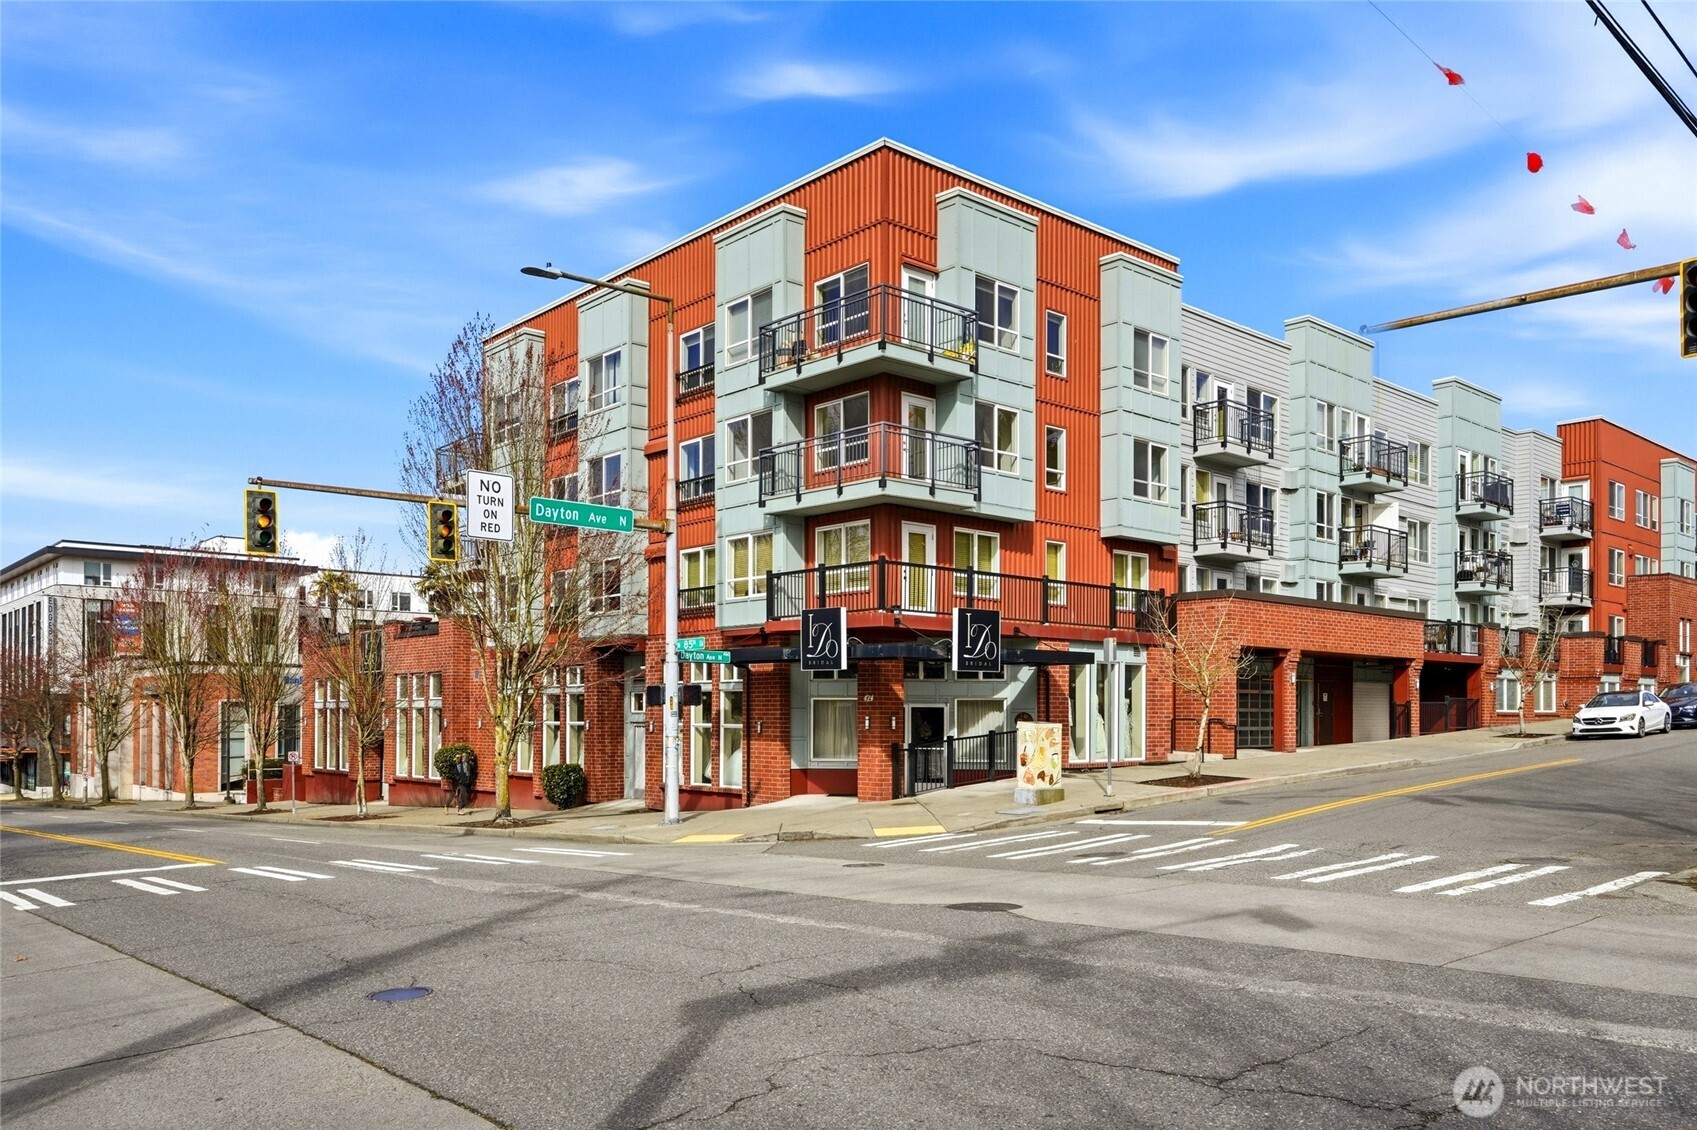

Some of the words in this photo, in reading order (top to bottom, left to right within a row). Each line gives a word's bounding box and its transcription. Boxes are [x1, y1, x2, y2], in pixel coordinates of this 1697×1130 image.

[480, 479, 501, 493] NO
[476, 494, 504, 507] TURN
[483, 509, 498, 519] ON
[535, 503, 579, 521] Dayton
[588, 512, 607, 524] Ave
[619, 516, 627, 527] N
[480, 522, 501, 533] RED
[680, 650, 705, 661] Dayton
